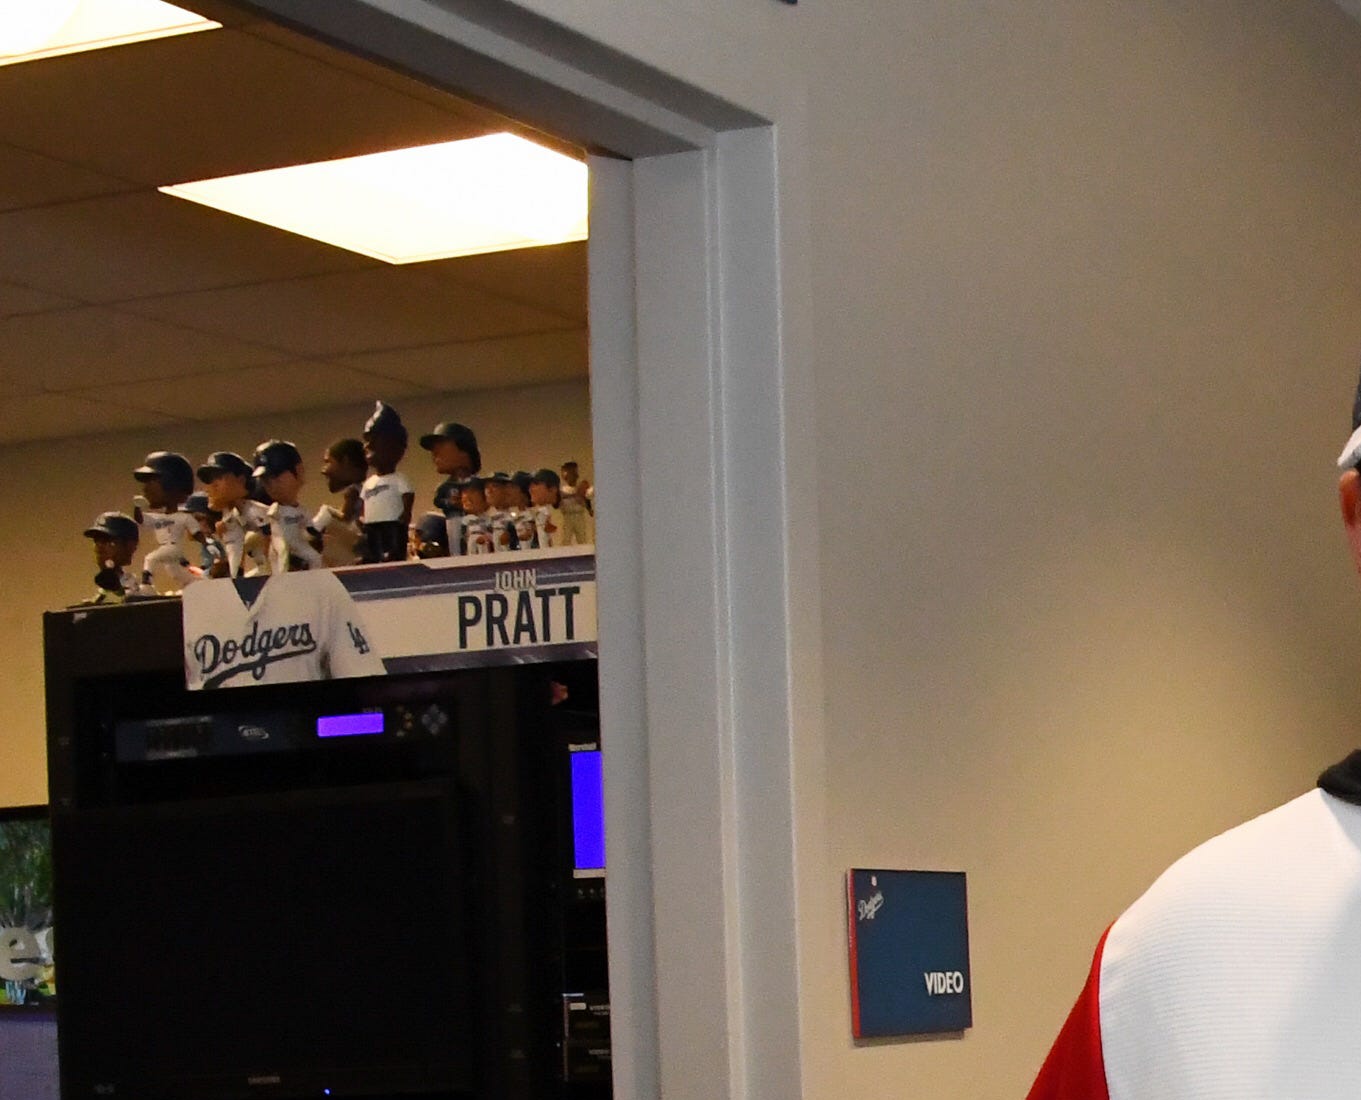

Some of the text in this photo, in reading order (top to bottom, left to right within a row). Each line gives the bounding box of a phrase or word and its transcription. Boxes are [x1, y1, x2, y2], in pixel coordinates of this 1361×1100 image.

[494, 568, 537, 592] JOHN
[458, 586, 580, 649] PRATT
[194, 620, 317, 685] Dodgers
[924, 971, 964, 996] VIDEO
